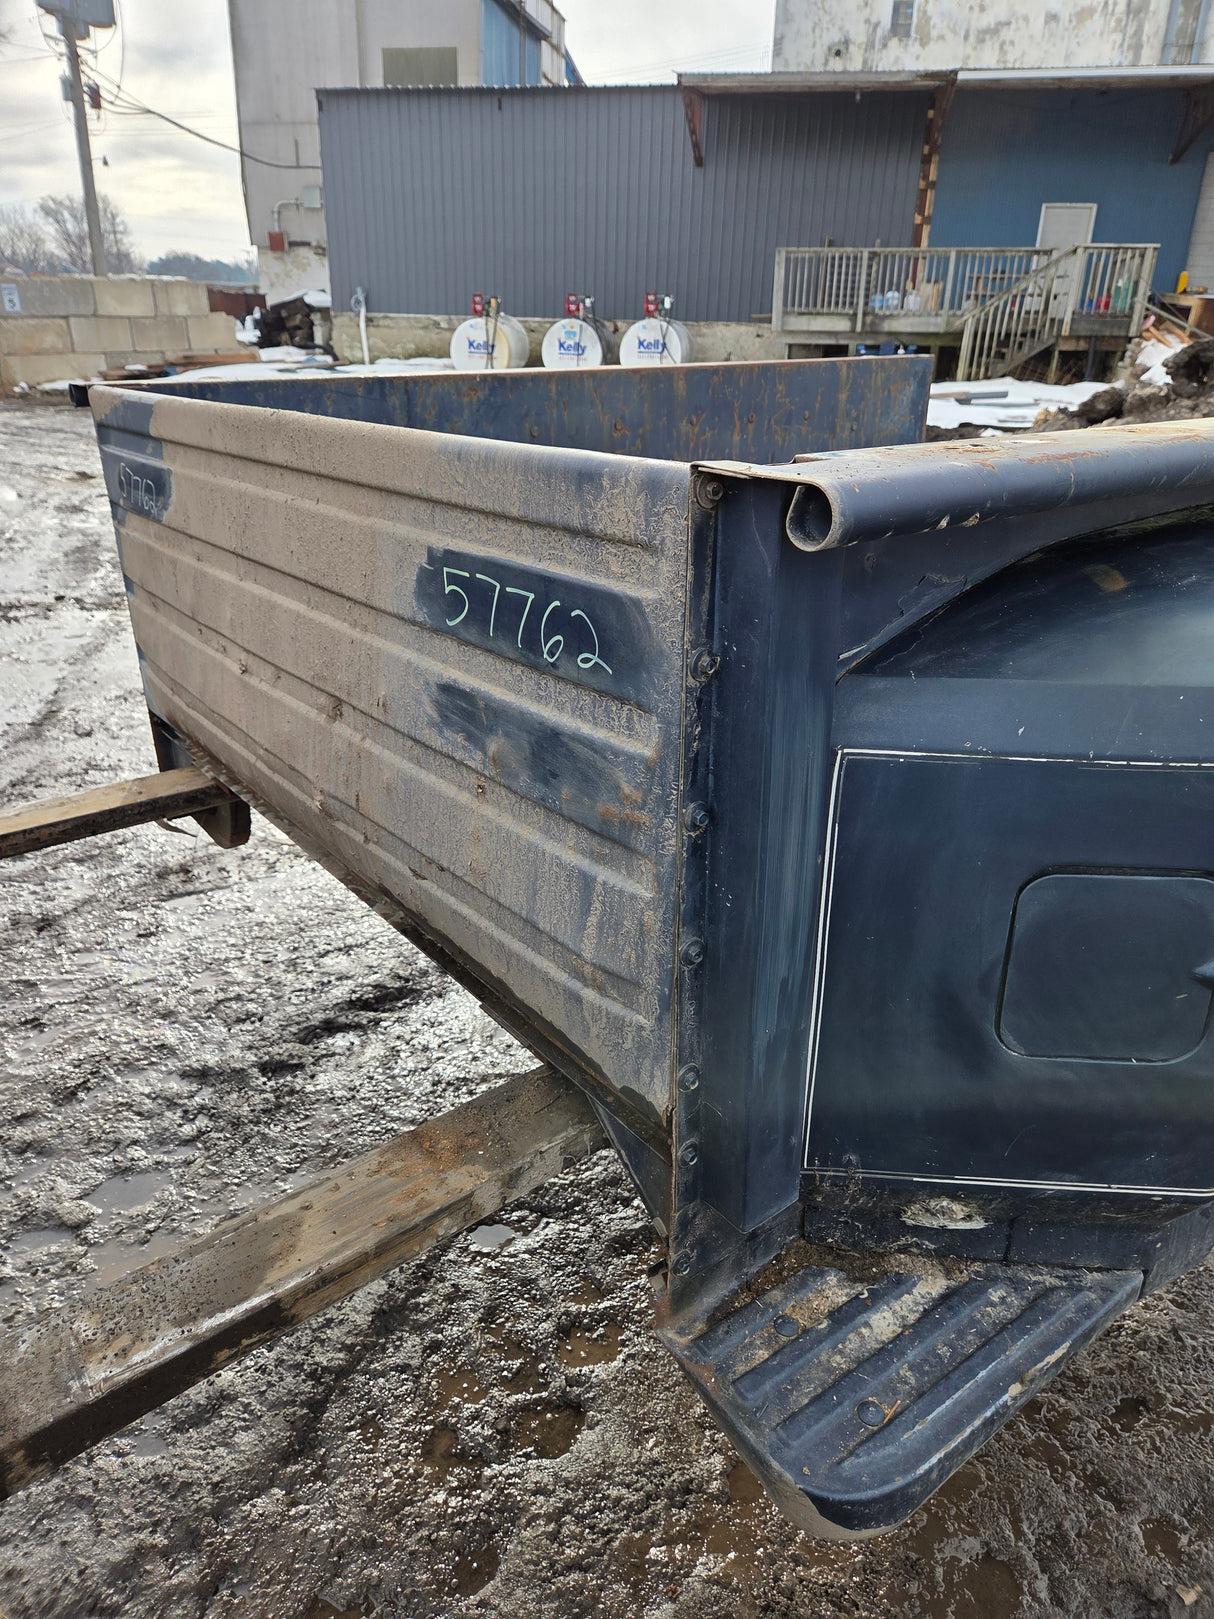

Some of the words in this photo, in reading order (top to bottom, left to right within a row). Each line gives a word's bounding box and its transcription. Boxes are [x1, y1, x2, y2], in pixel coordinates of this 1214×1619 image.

[558, 338, 587, 356] Kelly
[637, 336, 666, 354] Kelly
[120, 462, 158, 520] 57762
[443, 566, 613, 675] 57762
